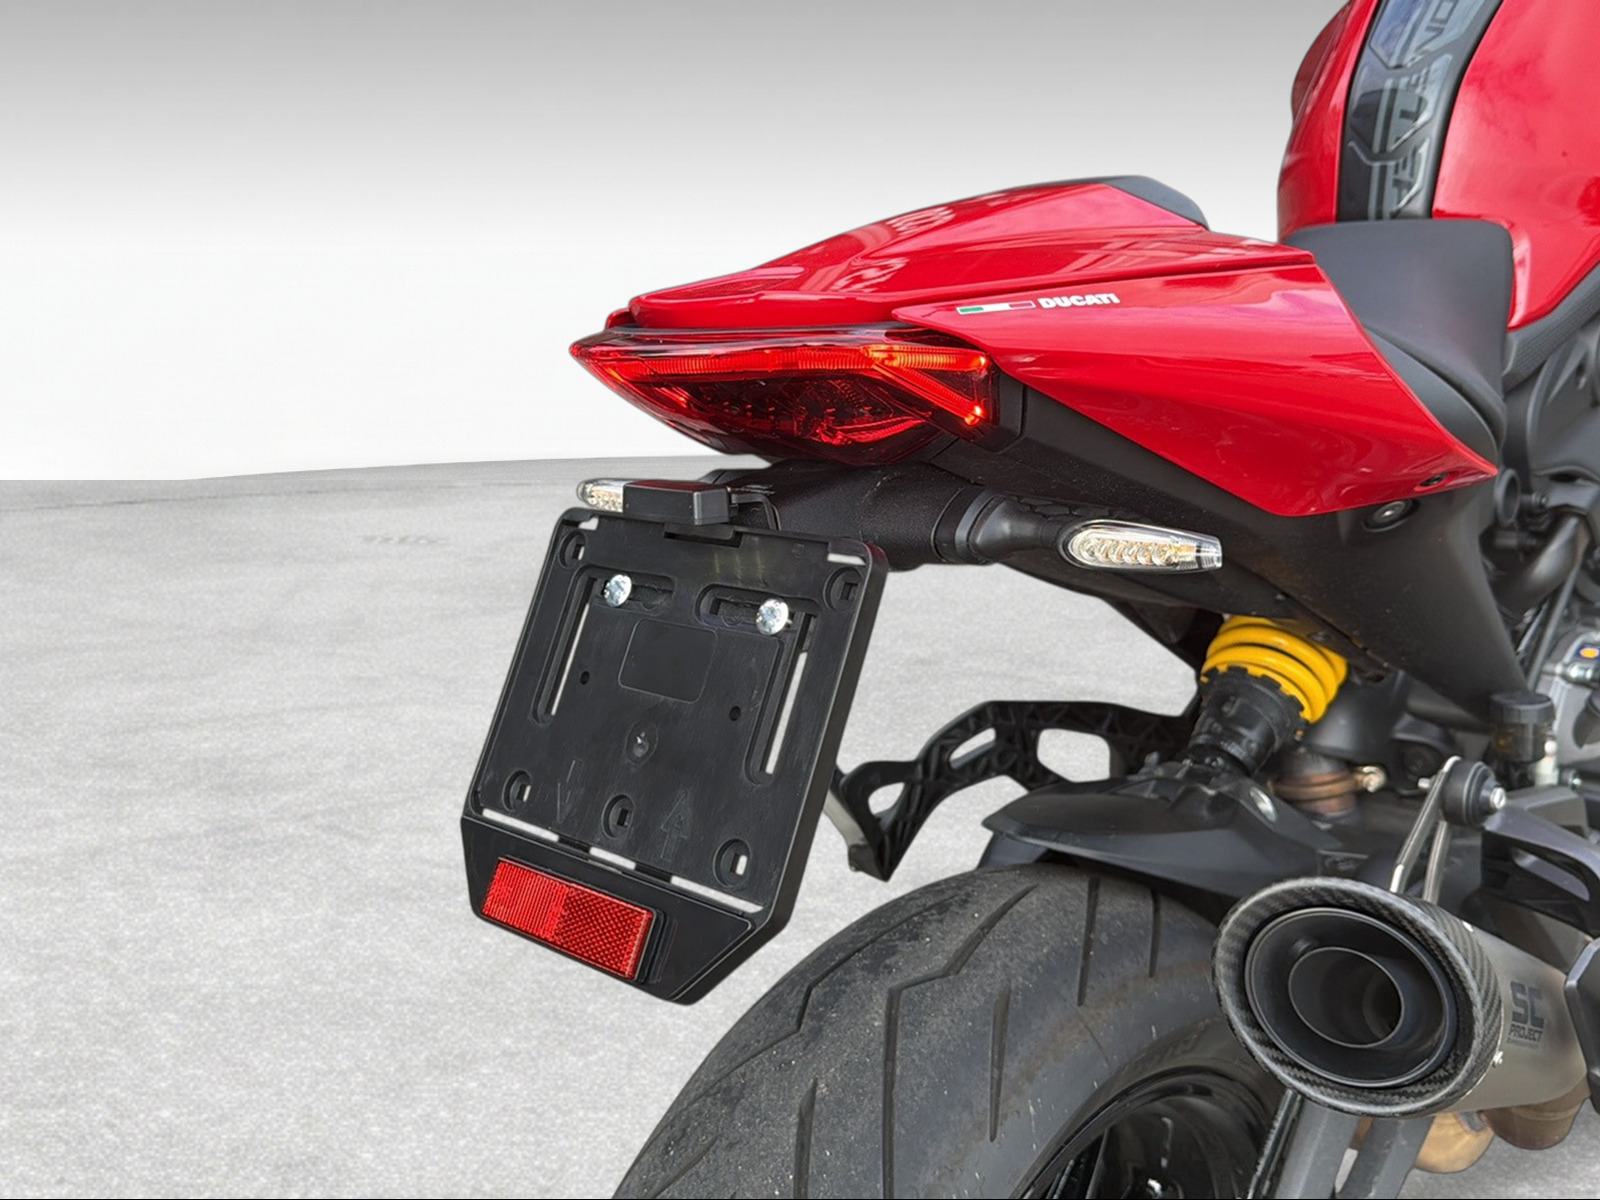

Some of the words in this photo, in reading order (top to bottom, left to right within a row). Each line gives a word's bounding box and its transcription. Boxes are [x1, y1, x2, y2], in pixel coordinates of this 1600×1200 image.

[1038, 293, 1120, 308] DUCATI
[1510, 981, 1545, 1029] SC
[1508, 1024, 1543, 1042] PROJECT
